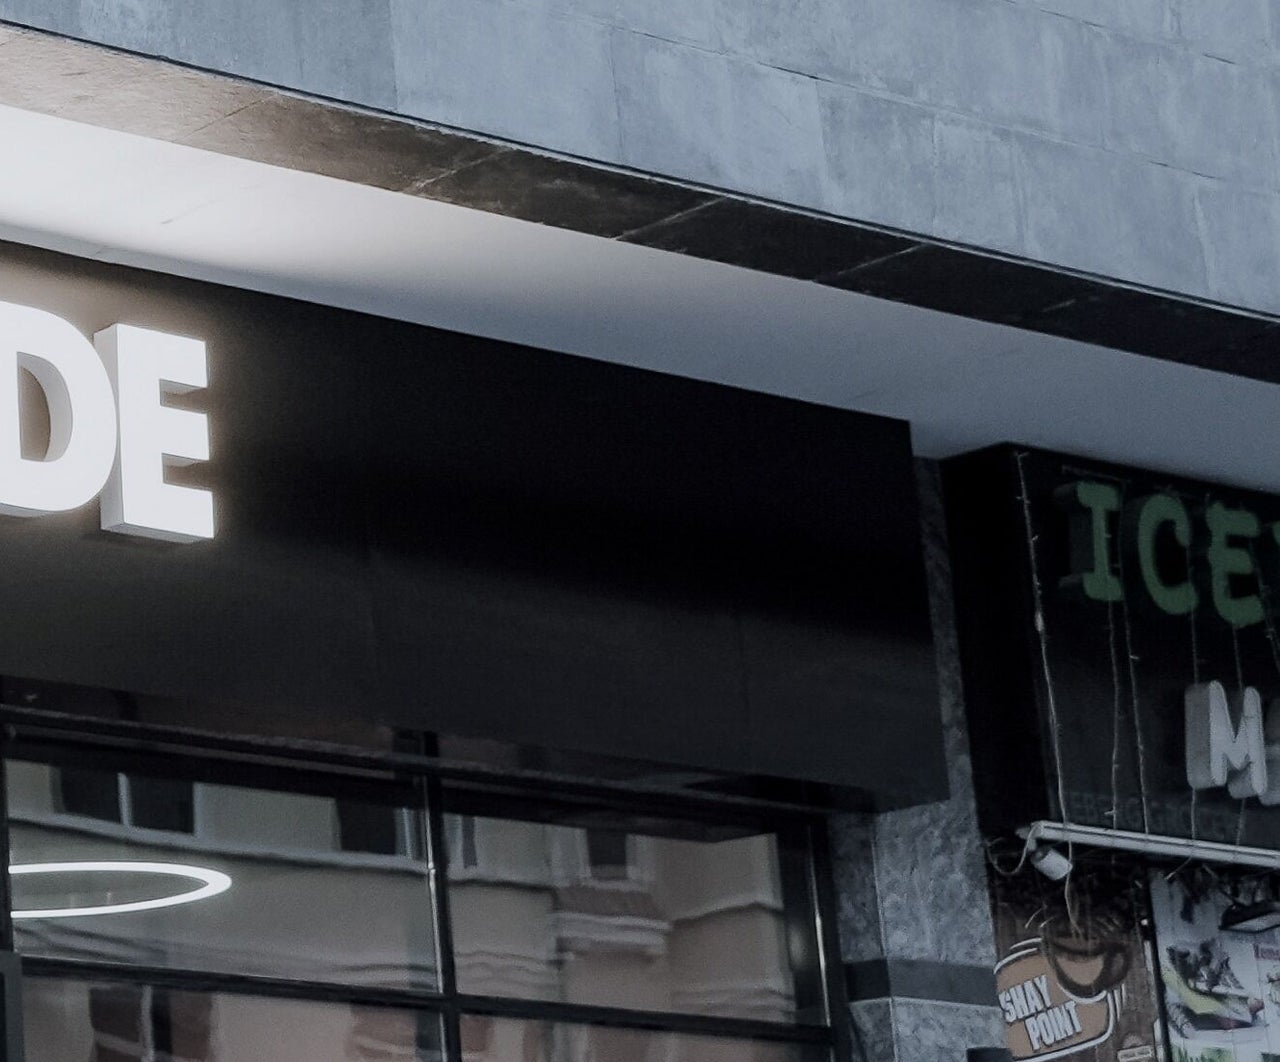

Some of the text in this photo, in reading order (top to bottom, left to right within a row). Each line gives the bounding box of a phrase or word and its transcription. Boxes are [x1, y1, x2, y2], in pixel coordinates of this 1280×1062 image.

[1076, 480, 1280, 629] ICE
[998, 974, 1052, 1024] SHAY
[1024, 1000, 1083, 1051] POINT
